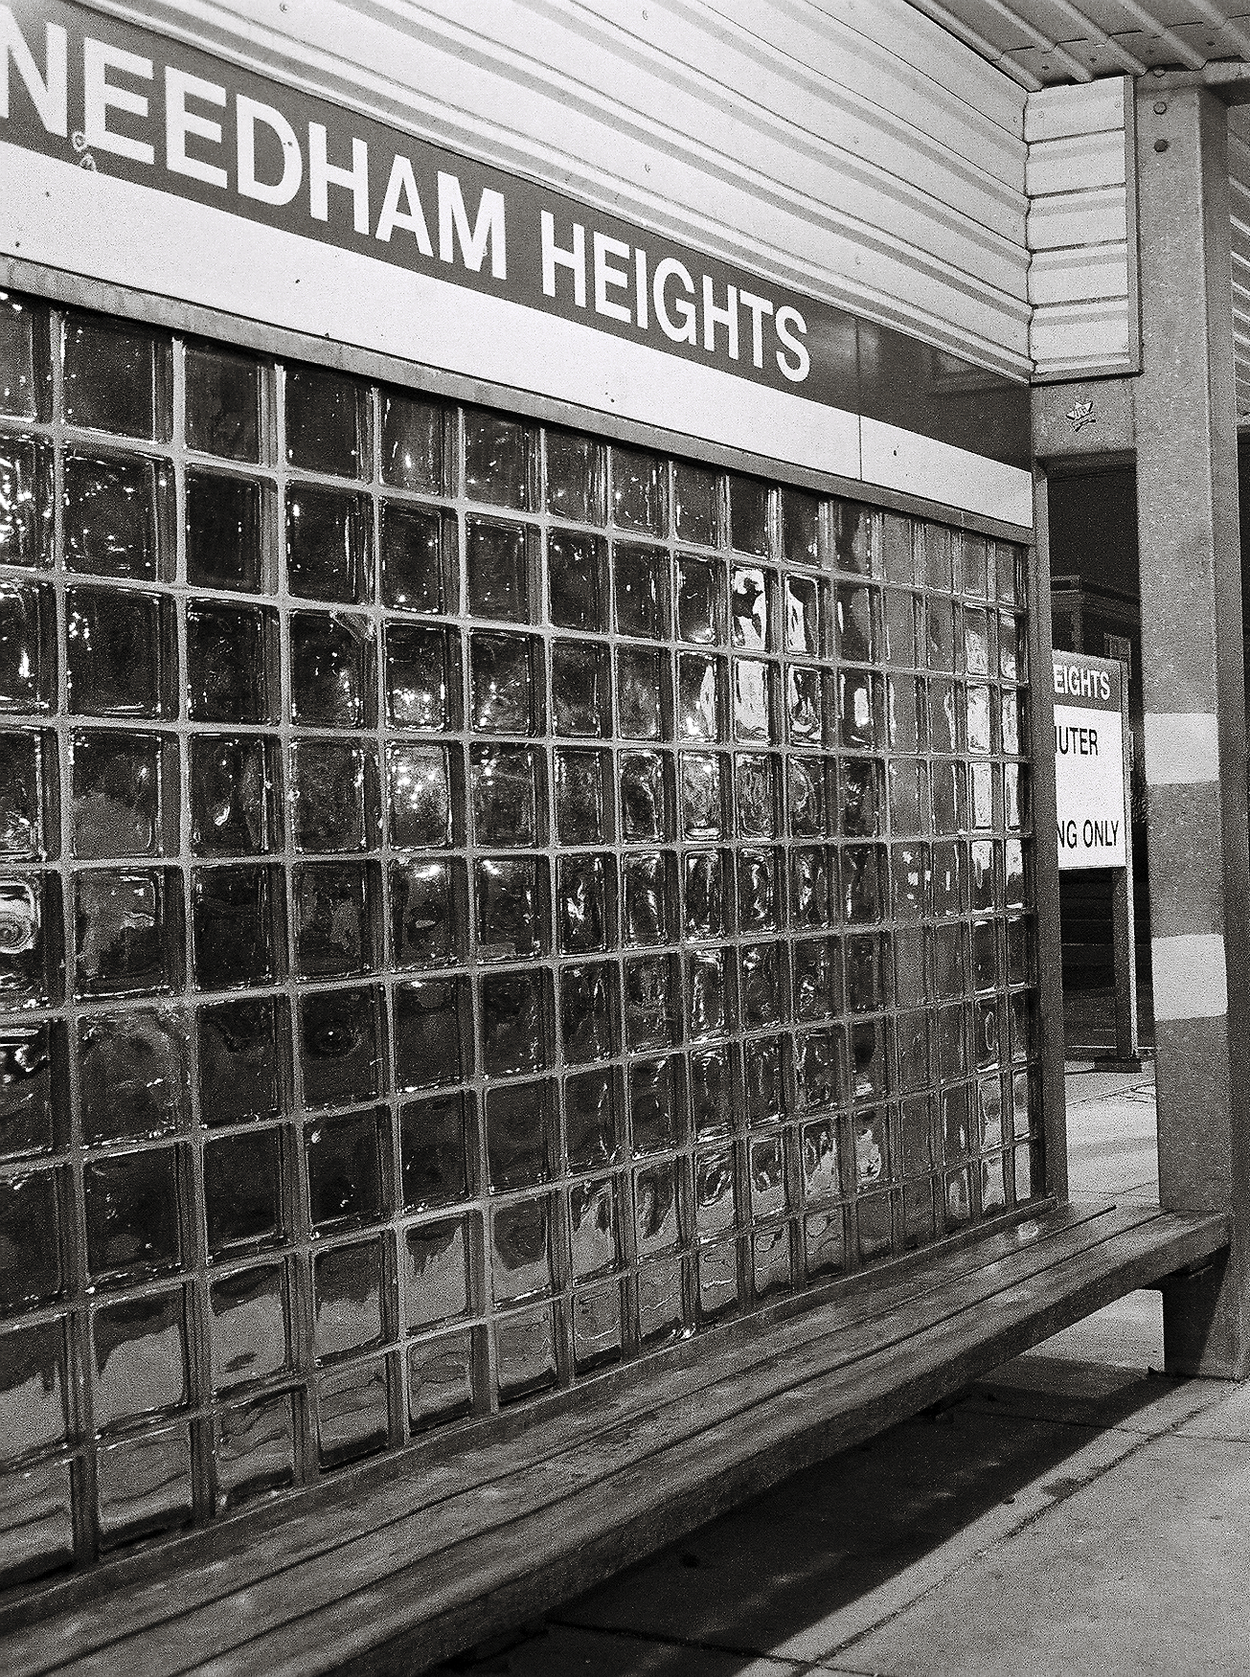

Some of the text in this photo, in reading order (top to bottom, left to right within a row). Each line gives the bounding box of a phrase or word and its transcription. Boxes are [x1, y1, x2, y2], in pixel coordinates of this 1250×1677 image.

[0, 18, 814, 384] NEEDHAM HEIGHTS
[1055, 725, 1099, 756] UTER
[1083, 819, 1119, 848] ONLY
